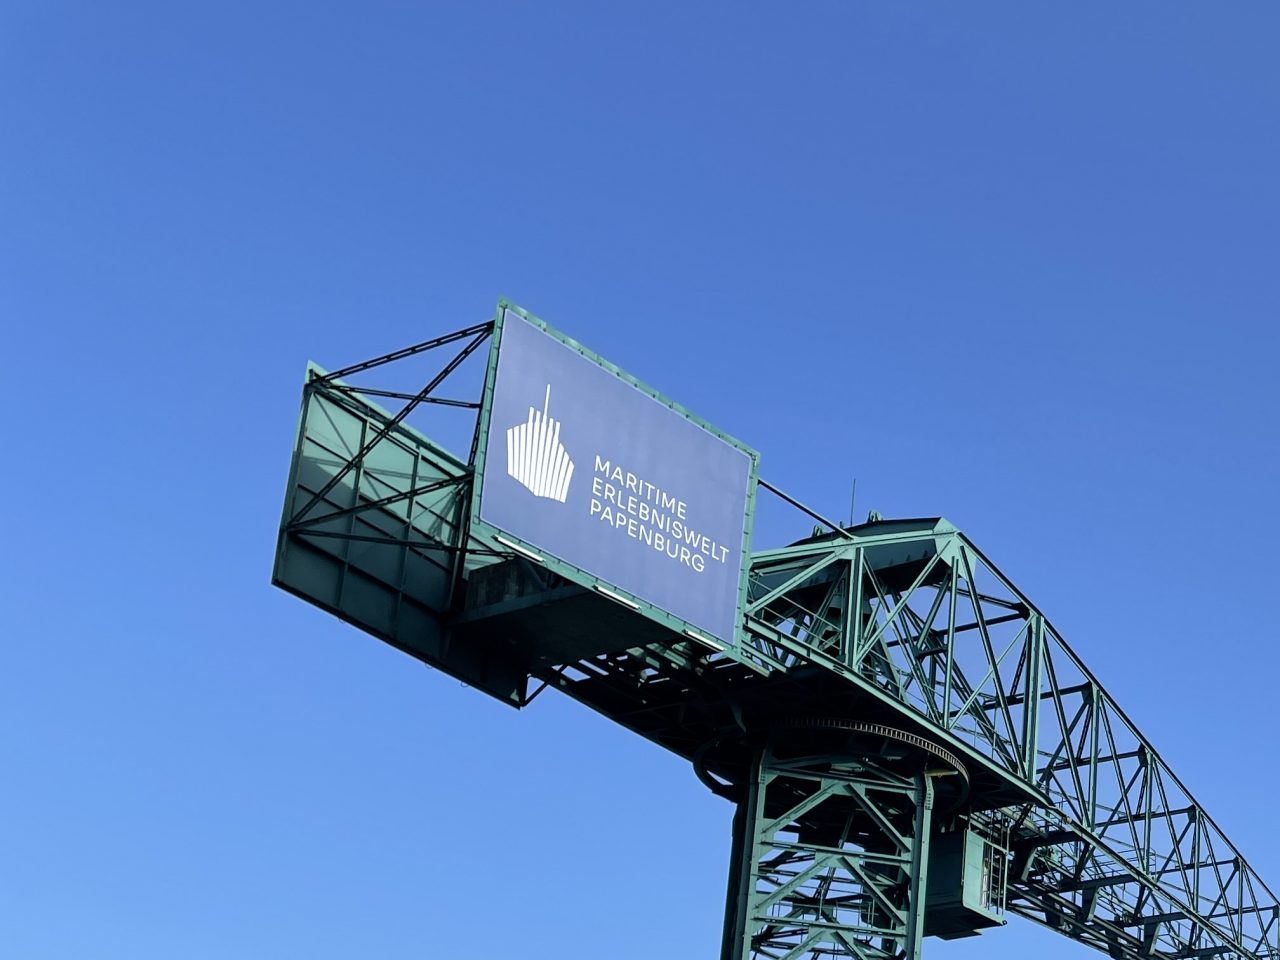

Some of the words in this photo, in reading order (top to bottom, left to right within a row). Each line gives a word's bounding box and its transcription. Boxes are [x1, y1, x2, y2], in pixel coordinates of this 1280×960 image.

[592, 477, 729, 563] ERLEBNISWELT
[594, 455, 687, 520] MARITIME
[590, 499, 705, 573] PAPENBURG
